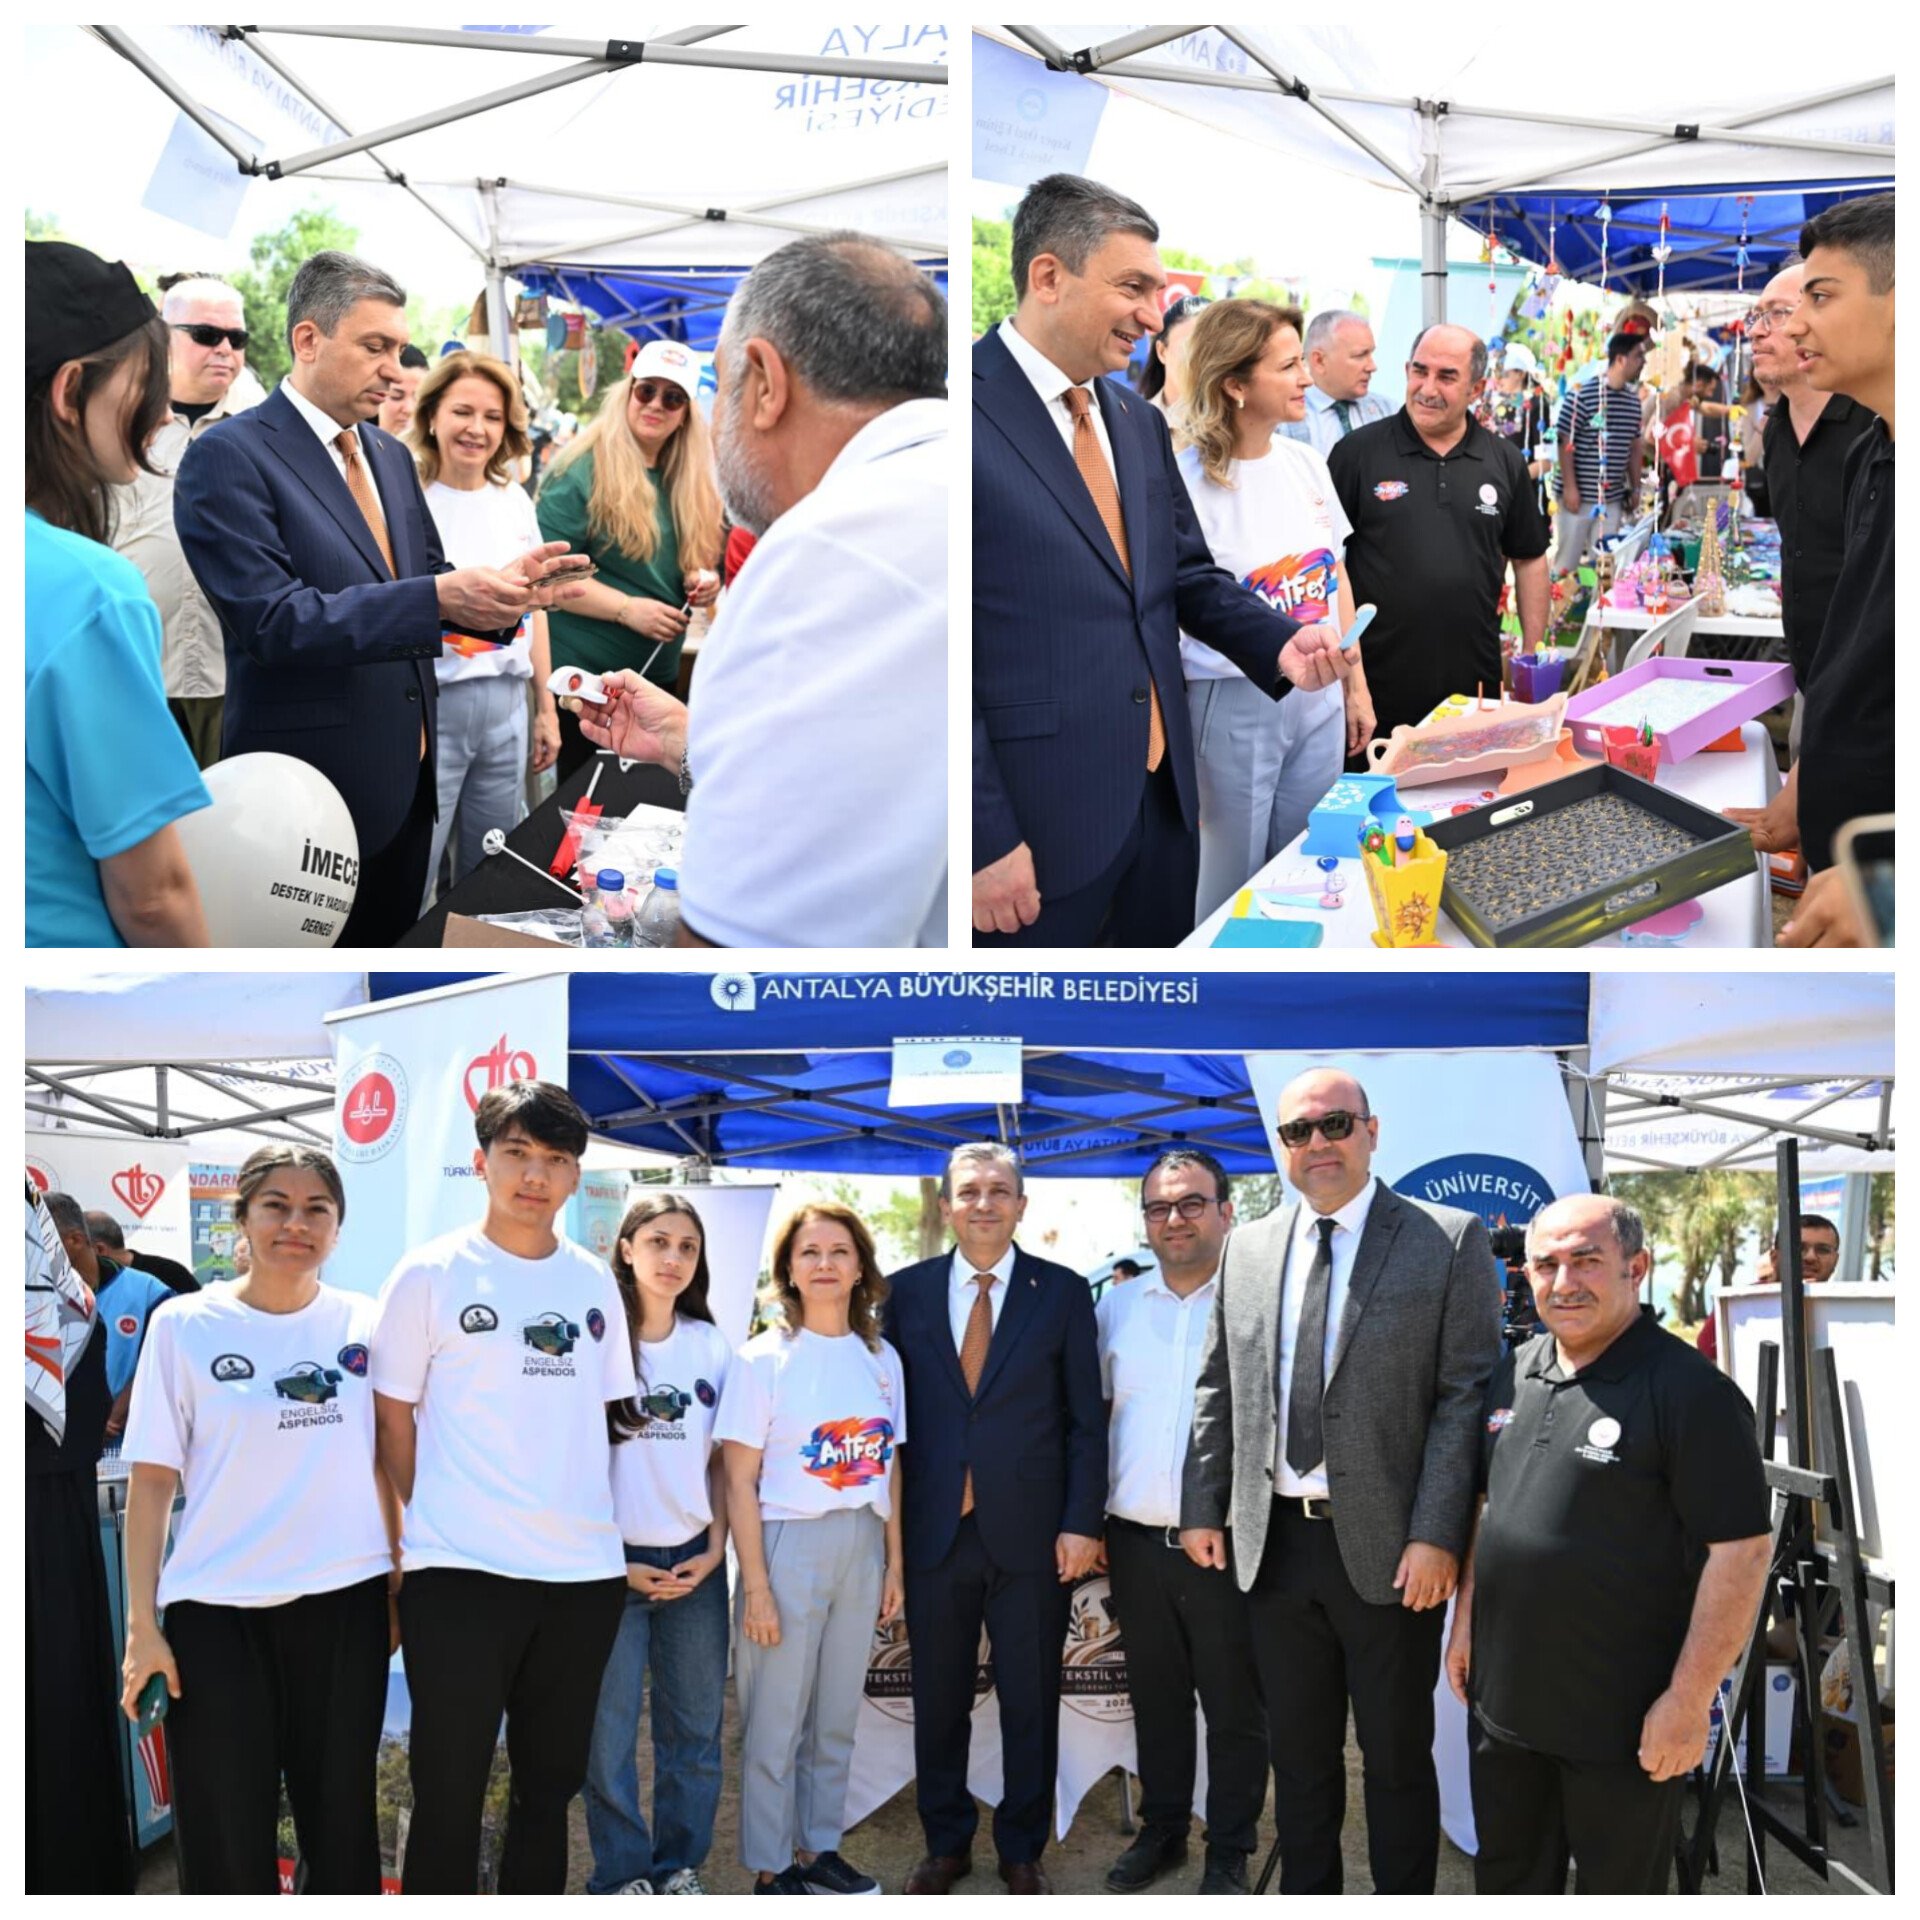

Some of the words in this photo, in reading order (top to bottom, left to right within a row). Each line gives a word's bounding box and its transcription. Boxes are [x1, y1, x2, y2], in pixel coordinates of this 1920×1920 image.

[301, 837, 359, 888] İMECE
[270, 881, 313, 905] DESTEK
[313, 892, 326, 907] VE
[761, 977, 893, 1000] ANTALYA
[899, 972, 1056, 1003] BÜYÜKŞEHİR
[1062, 975, 1199, 1005] BELEDİYESİ
[521, 1366, 576, 1377] ASPENDOS
[277, 1413, 344, 1431] ASPENDOS
[637, 1430, 687, 1441] ASPENDOS
